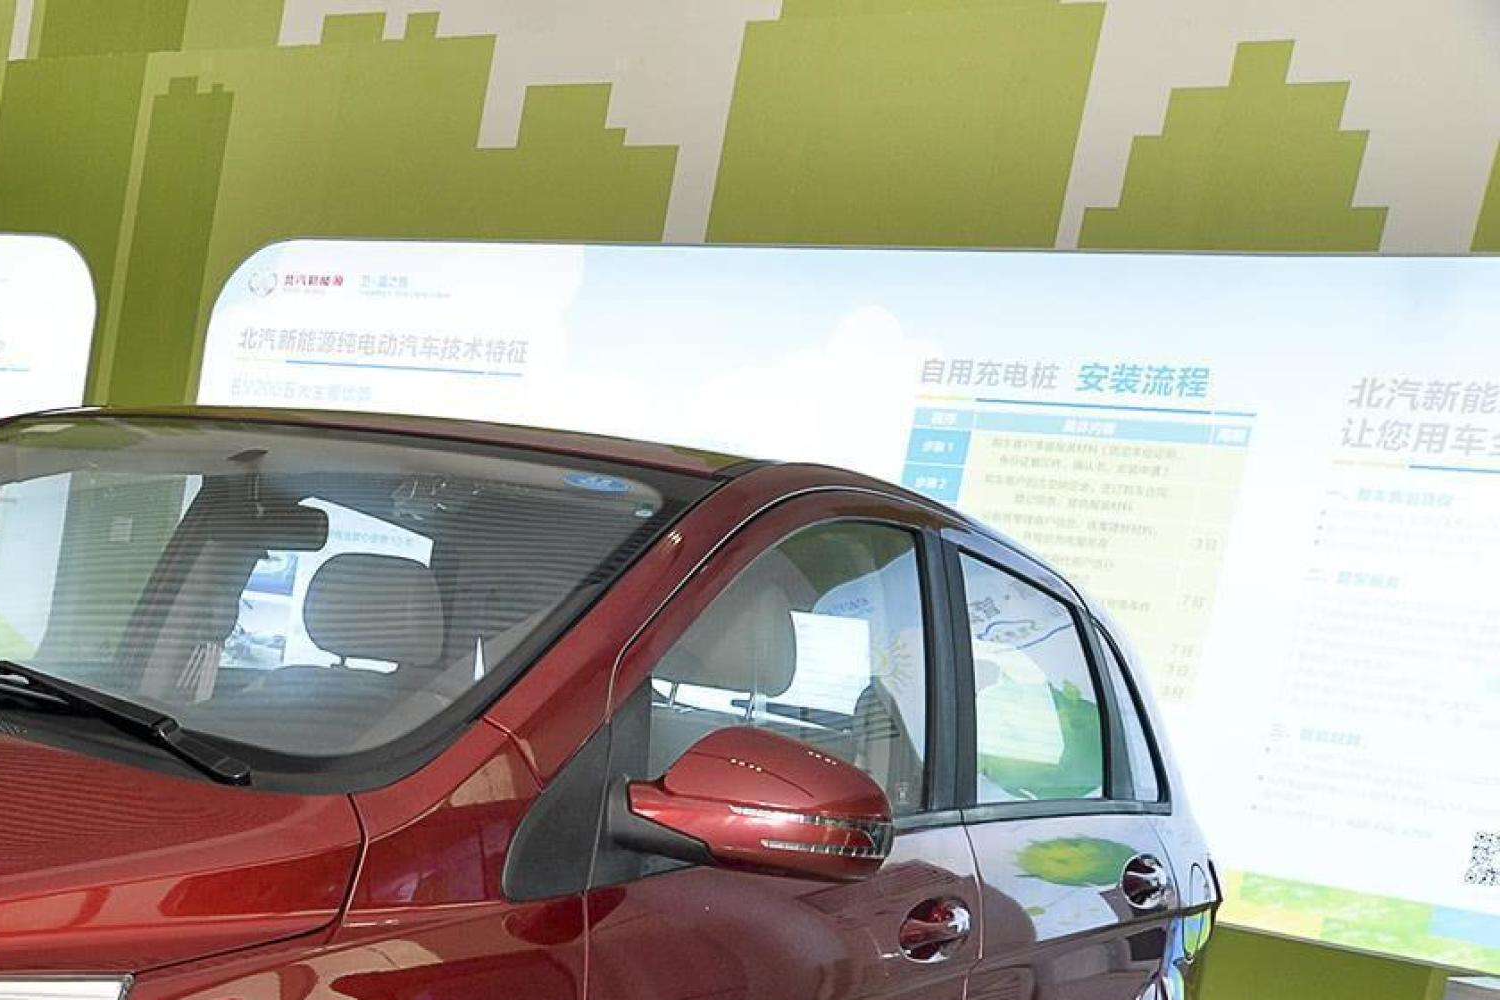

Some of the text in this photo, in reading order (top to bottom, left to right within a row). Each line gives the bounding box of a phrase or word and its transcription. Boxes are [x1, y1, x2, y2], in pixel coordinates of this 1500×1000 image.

[238, 326, 530, 364] 北汽新能源纯电动汽车技术特征
[921, 357, 1212, 399] 自用充电桩 安装流程
